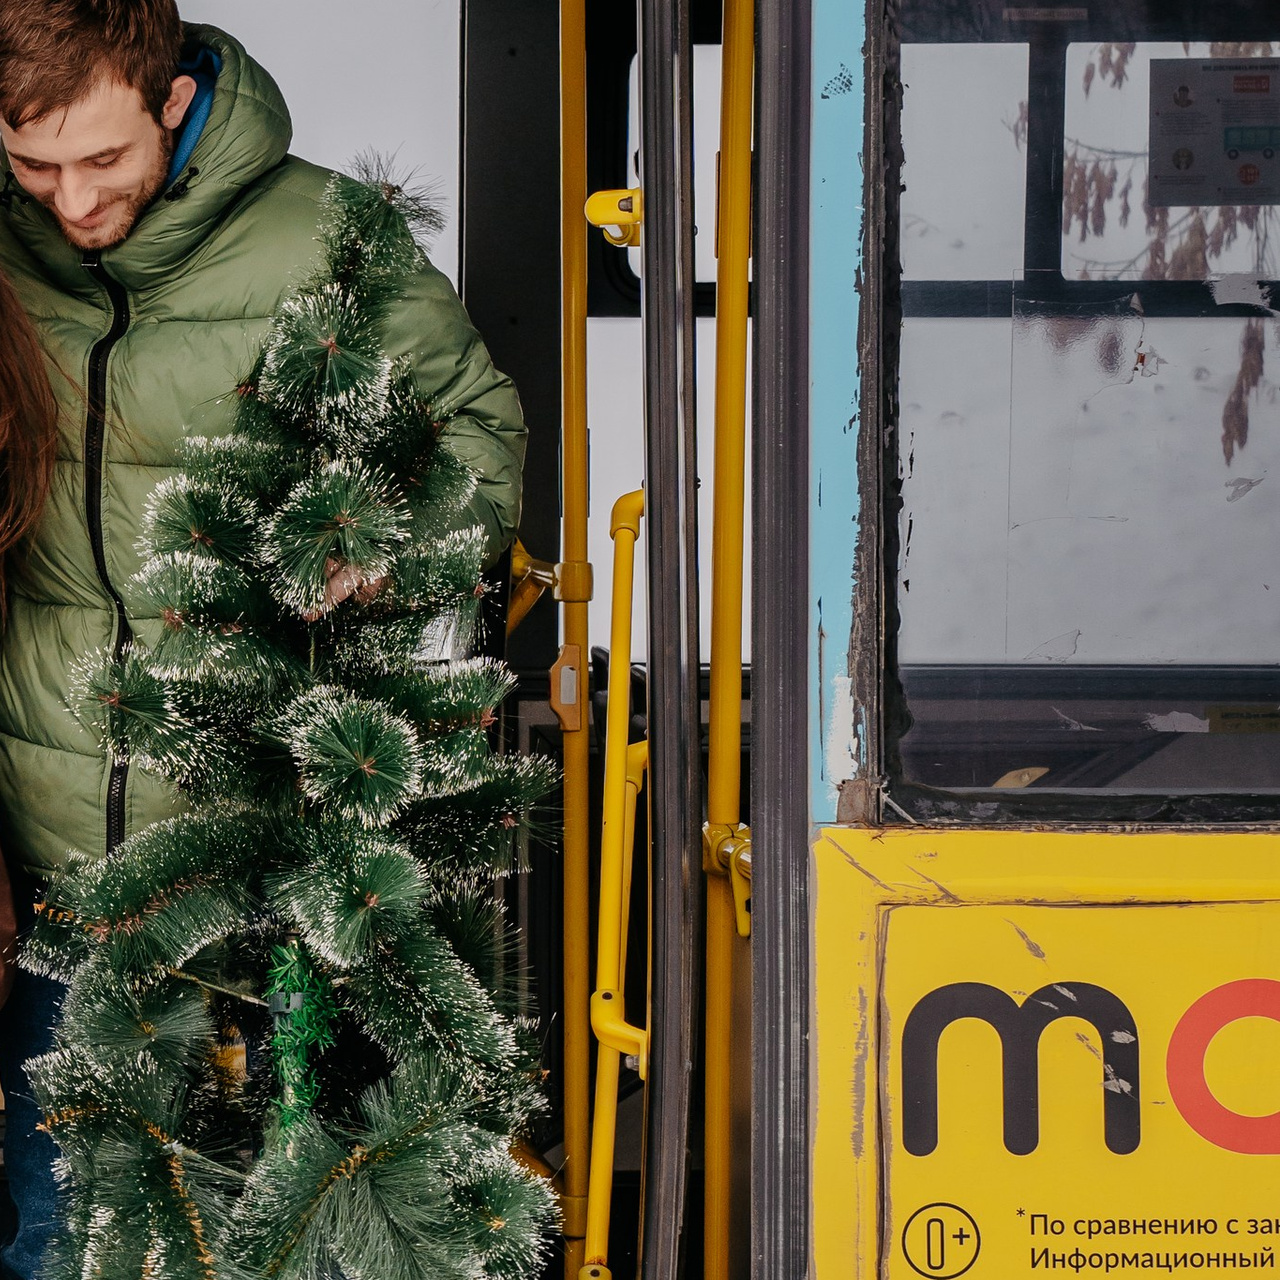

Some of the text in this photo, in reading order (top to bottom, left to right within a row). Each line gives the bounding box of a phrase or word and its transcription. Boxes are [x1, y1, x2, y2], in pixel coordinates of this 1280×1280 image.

[1073, 1218, 1218, 1240] сравнению
[1226, 1218, 1239, 1235] с
[1030, 1246, 1275, 1273] Информационный
